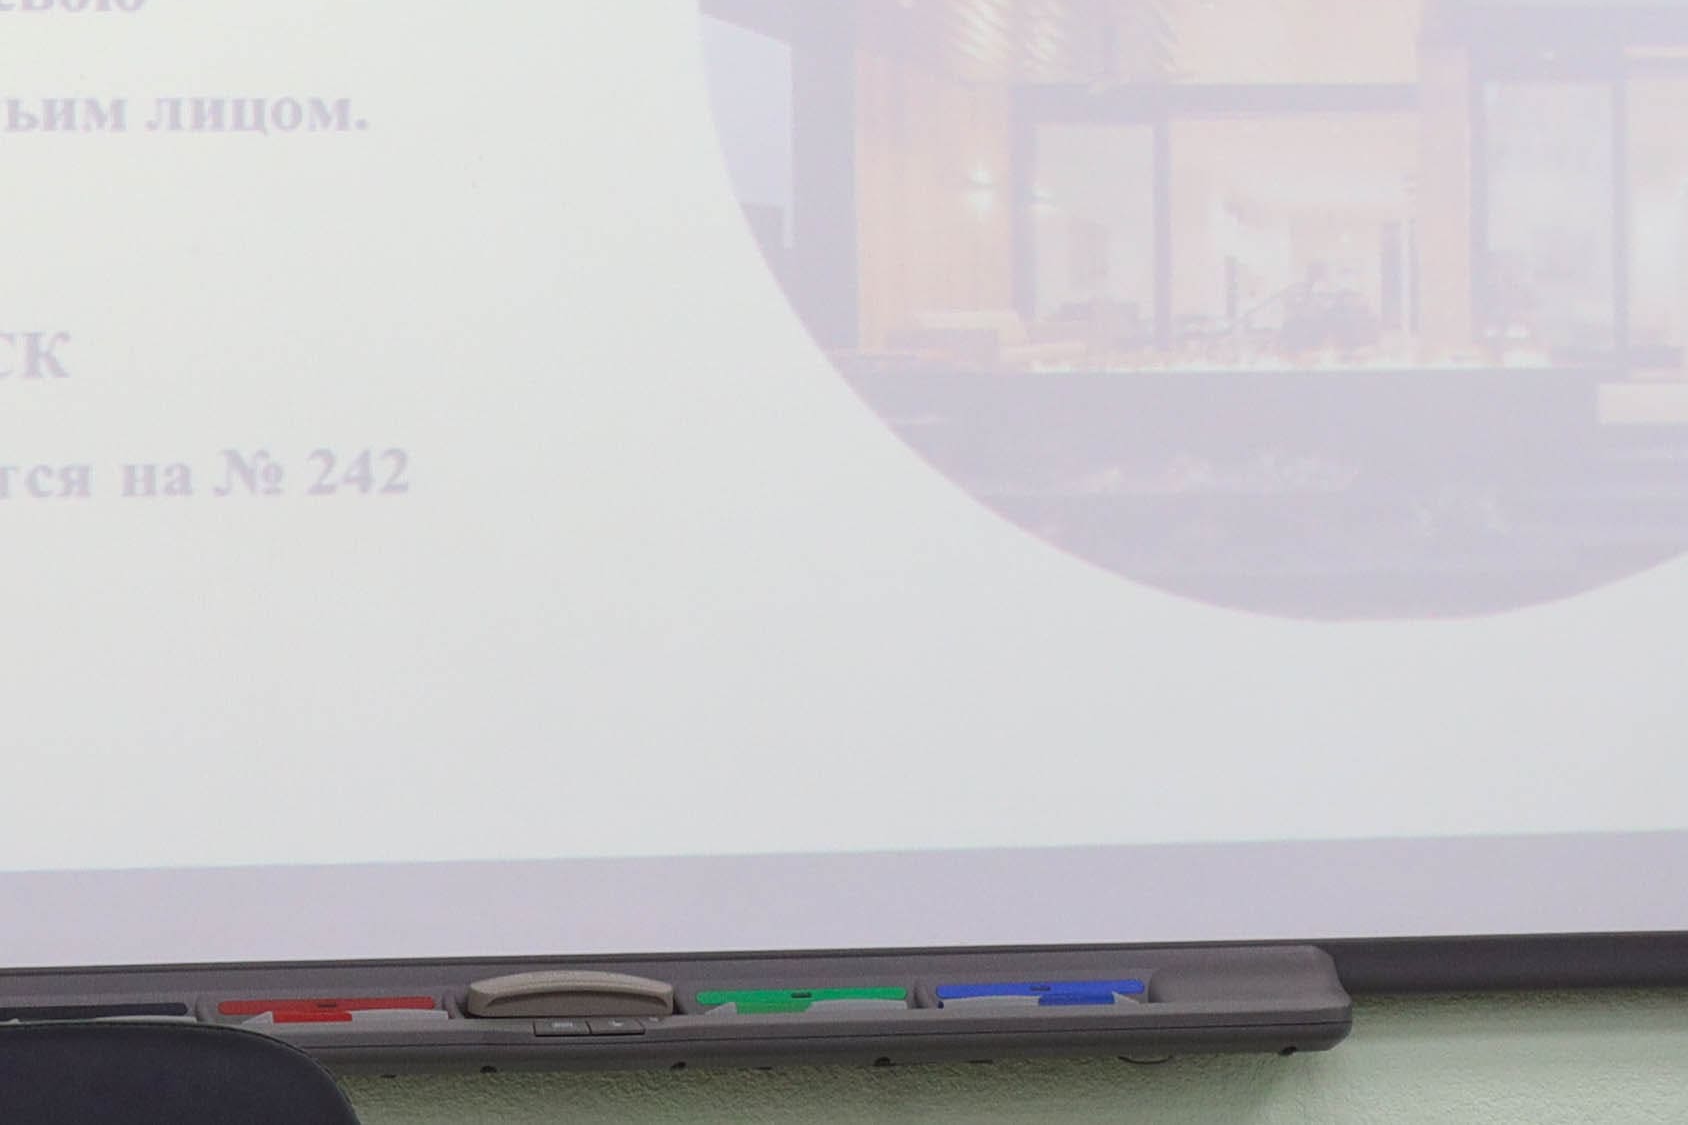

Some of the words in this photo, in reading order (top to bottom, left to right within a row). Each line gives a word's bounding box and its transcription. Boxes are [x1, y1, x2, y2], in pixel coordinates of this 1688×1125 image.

[145, 96, 370, 136] лицом.
[121, 462, 194, 498] на
[213, 448, 286, 497] №
[306, 446, 410, 496] 242
